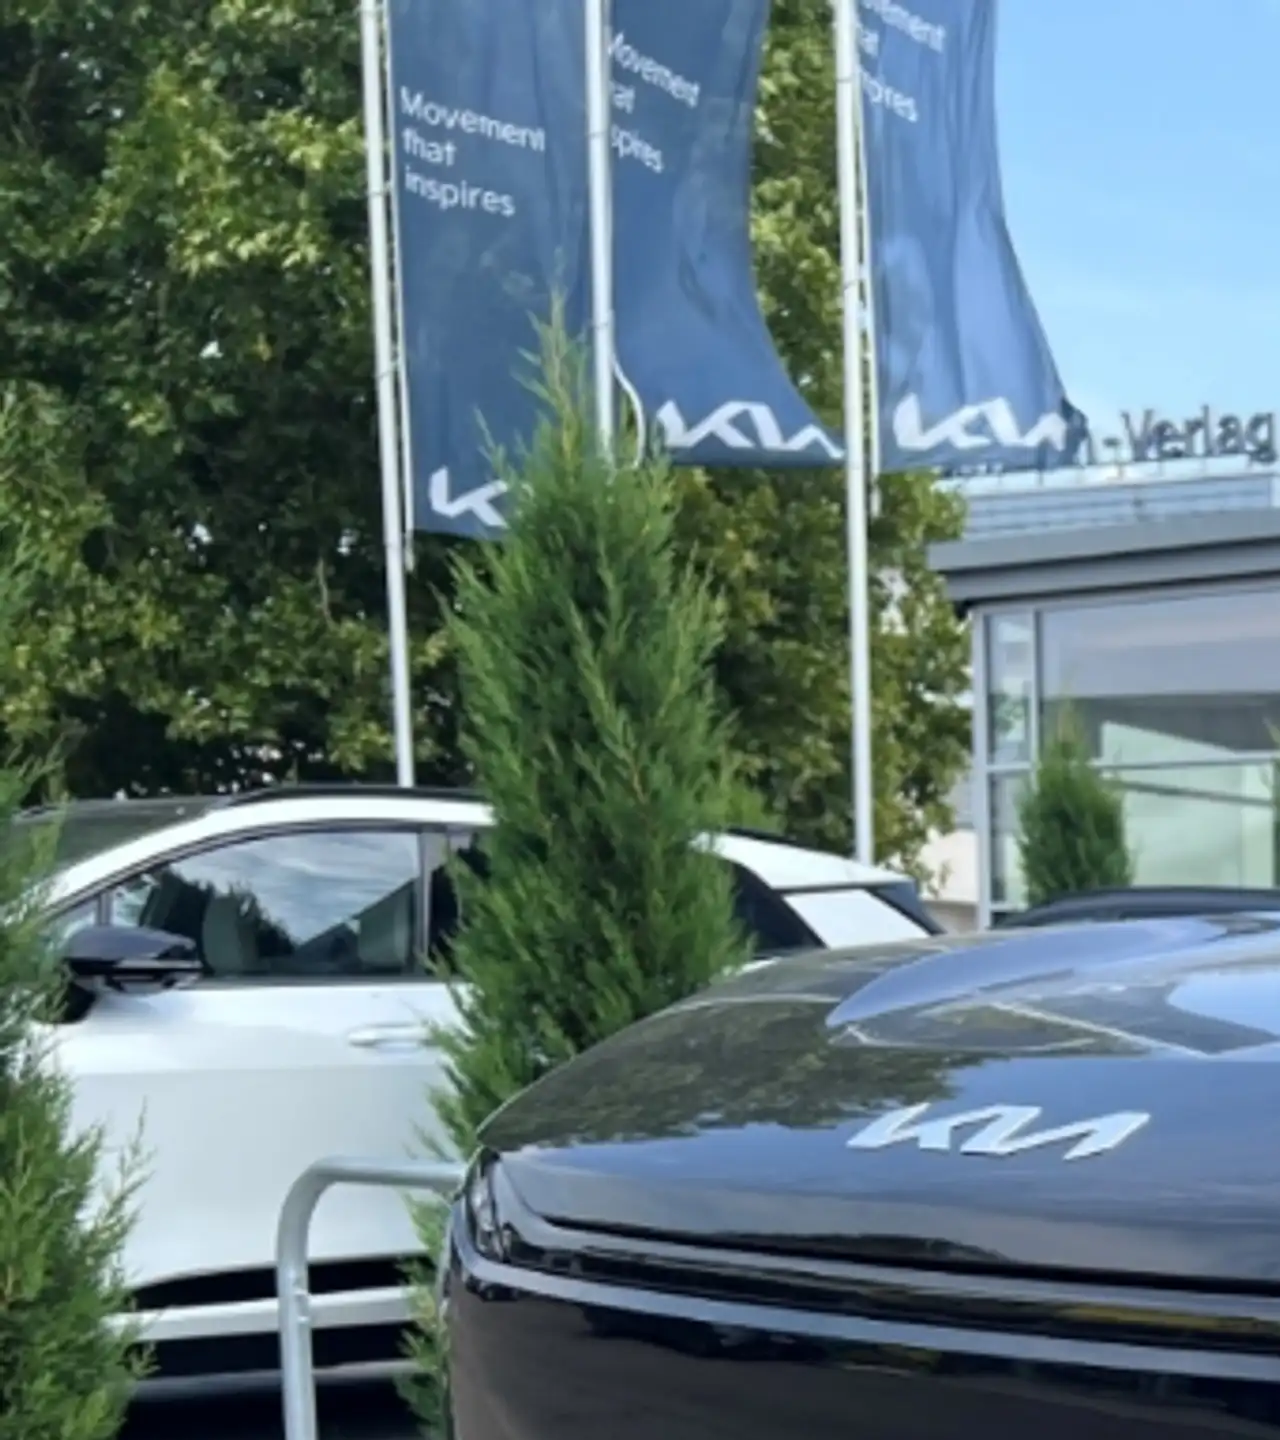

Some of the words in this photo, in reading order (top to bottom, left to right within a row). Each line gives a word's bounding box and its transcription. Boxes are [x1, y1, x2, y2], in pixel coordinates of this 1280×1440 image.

[400, 85, 545, 152] Movement
[402, 127, 455, 167] that
[404, 164, 515, 217] inspires
[656, 400, 845, 459] KIA
[1084, 404, 1278, 465] -Verlag
[846, 1102, 1151, 1160] KIA
